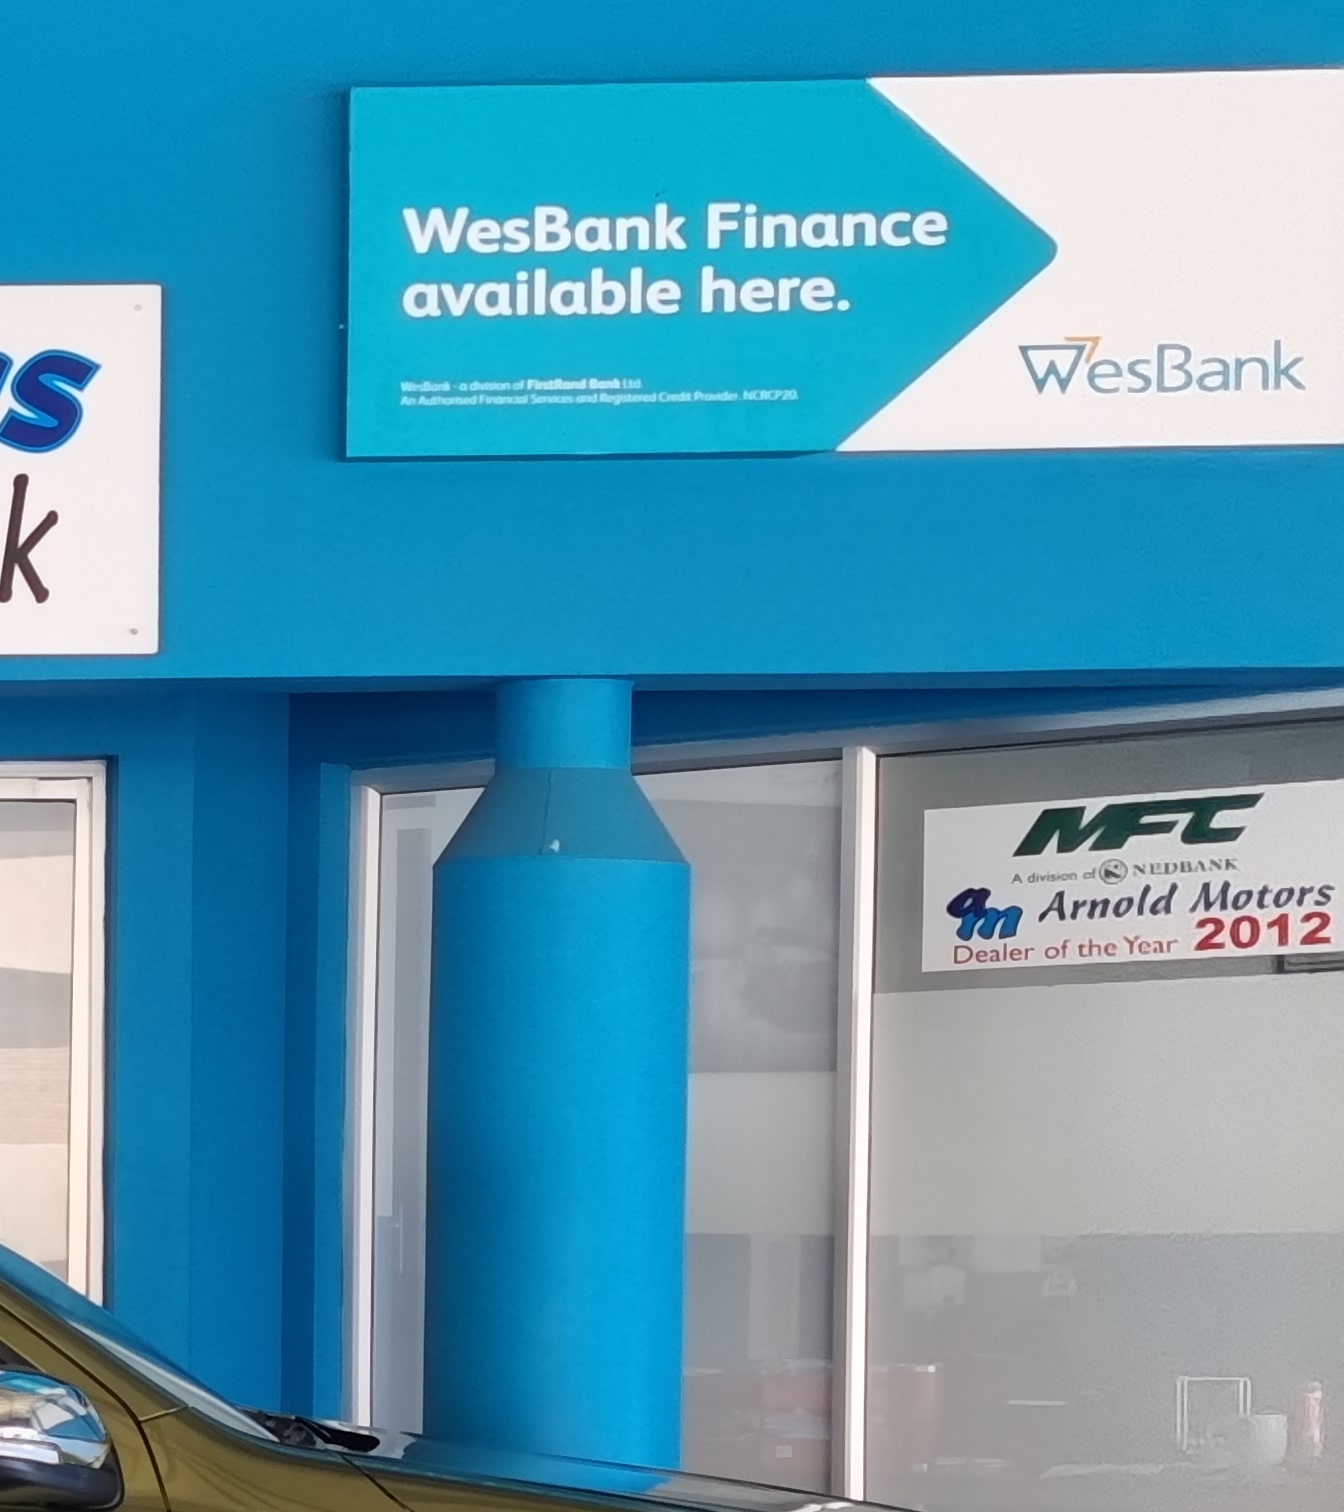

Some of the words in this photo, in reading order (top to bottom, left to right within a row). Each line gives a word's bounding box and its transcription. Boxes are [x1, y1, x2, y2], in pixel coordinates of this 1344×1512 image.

[402, 203, 686, 254] WesBank
[707, 202, 948, 250] Finance
[402, 266, 681, 318] available
[701, 265, 850, 313] here.
[469, 381, 510, 390] division
[527, 378, 587, 390] FirstRand
[589, 378, 620, 389] Bank
[1018, 337, 1306, 394] WesBank
[1012, 793, 1264, 857] MFC
[1012, 873, 1023, 884] A
[1027, 870, 1078, 883] division
[1133, 857, 1238, 876] NEDBANK
[1038, 882, 1179, 922] Arnold
[1189, 880, 1336, 914] Motors
[953, 943, 1035, 965] Dealer
[1045, 939, 1070, 959] of
[1078, 938, 1118, 958] the
[1123, 936, 1179, 956] Year
[1193, 911, 1332, 951] 2012
